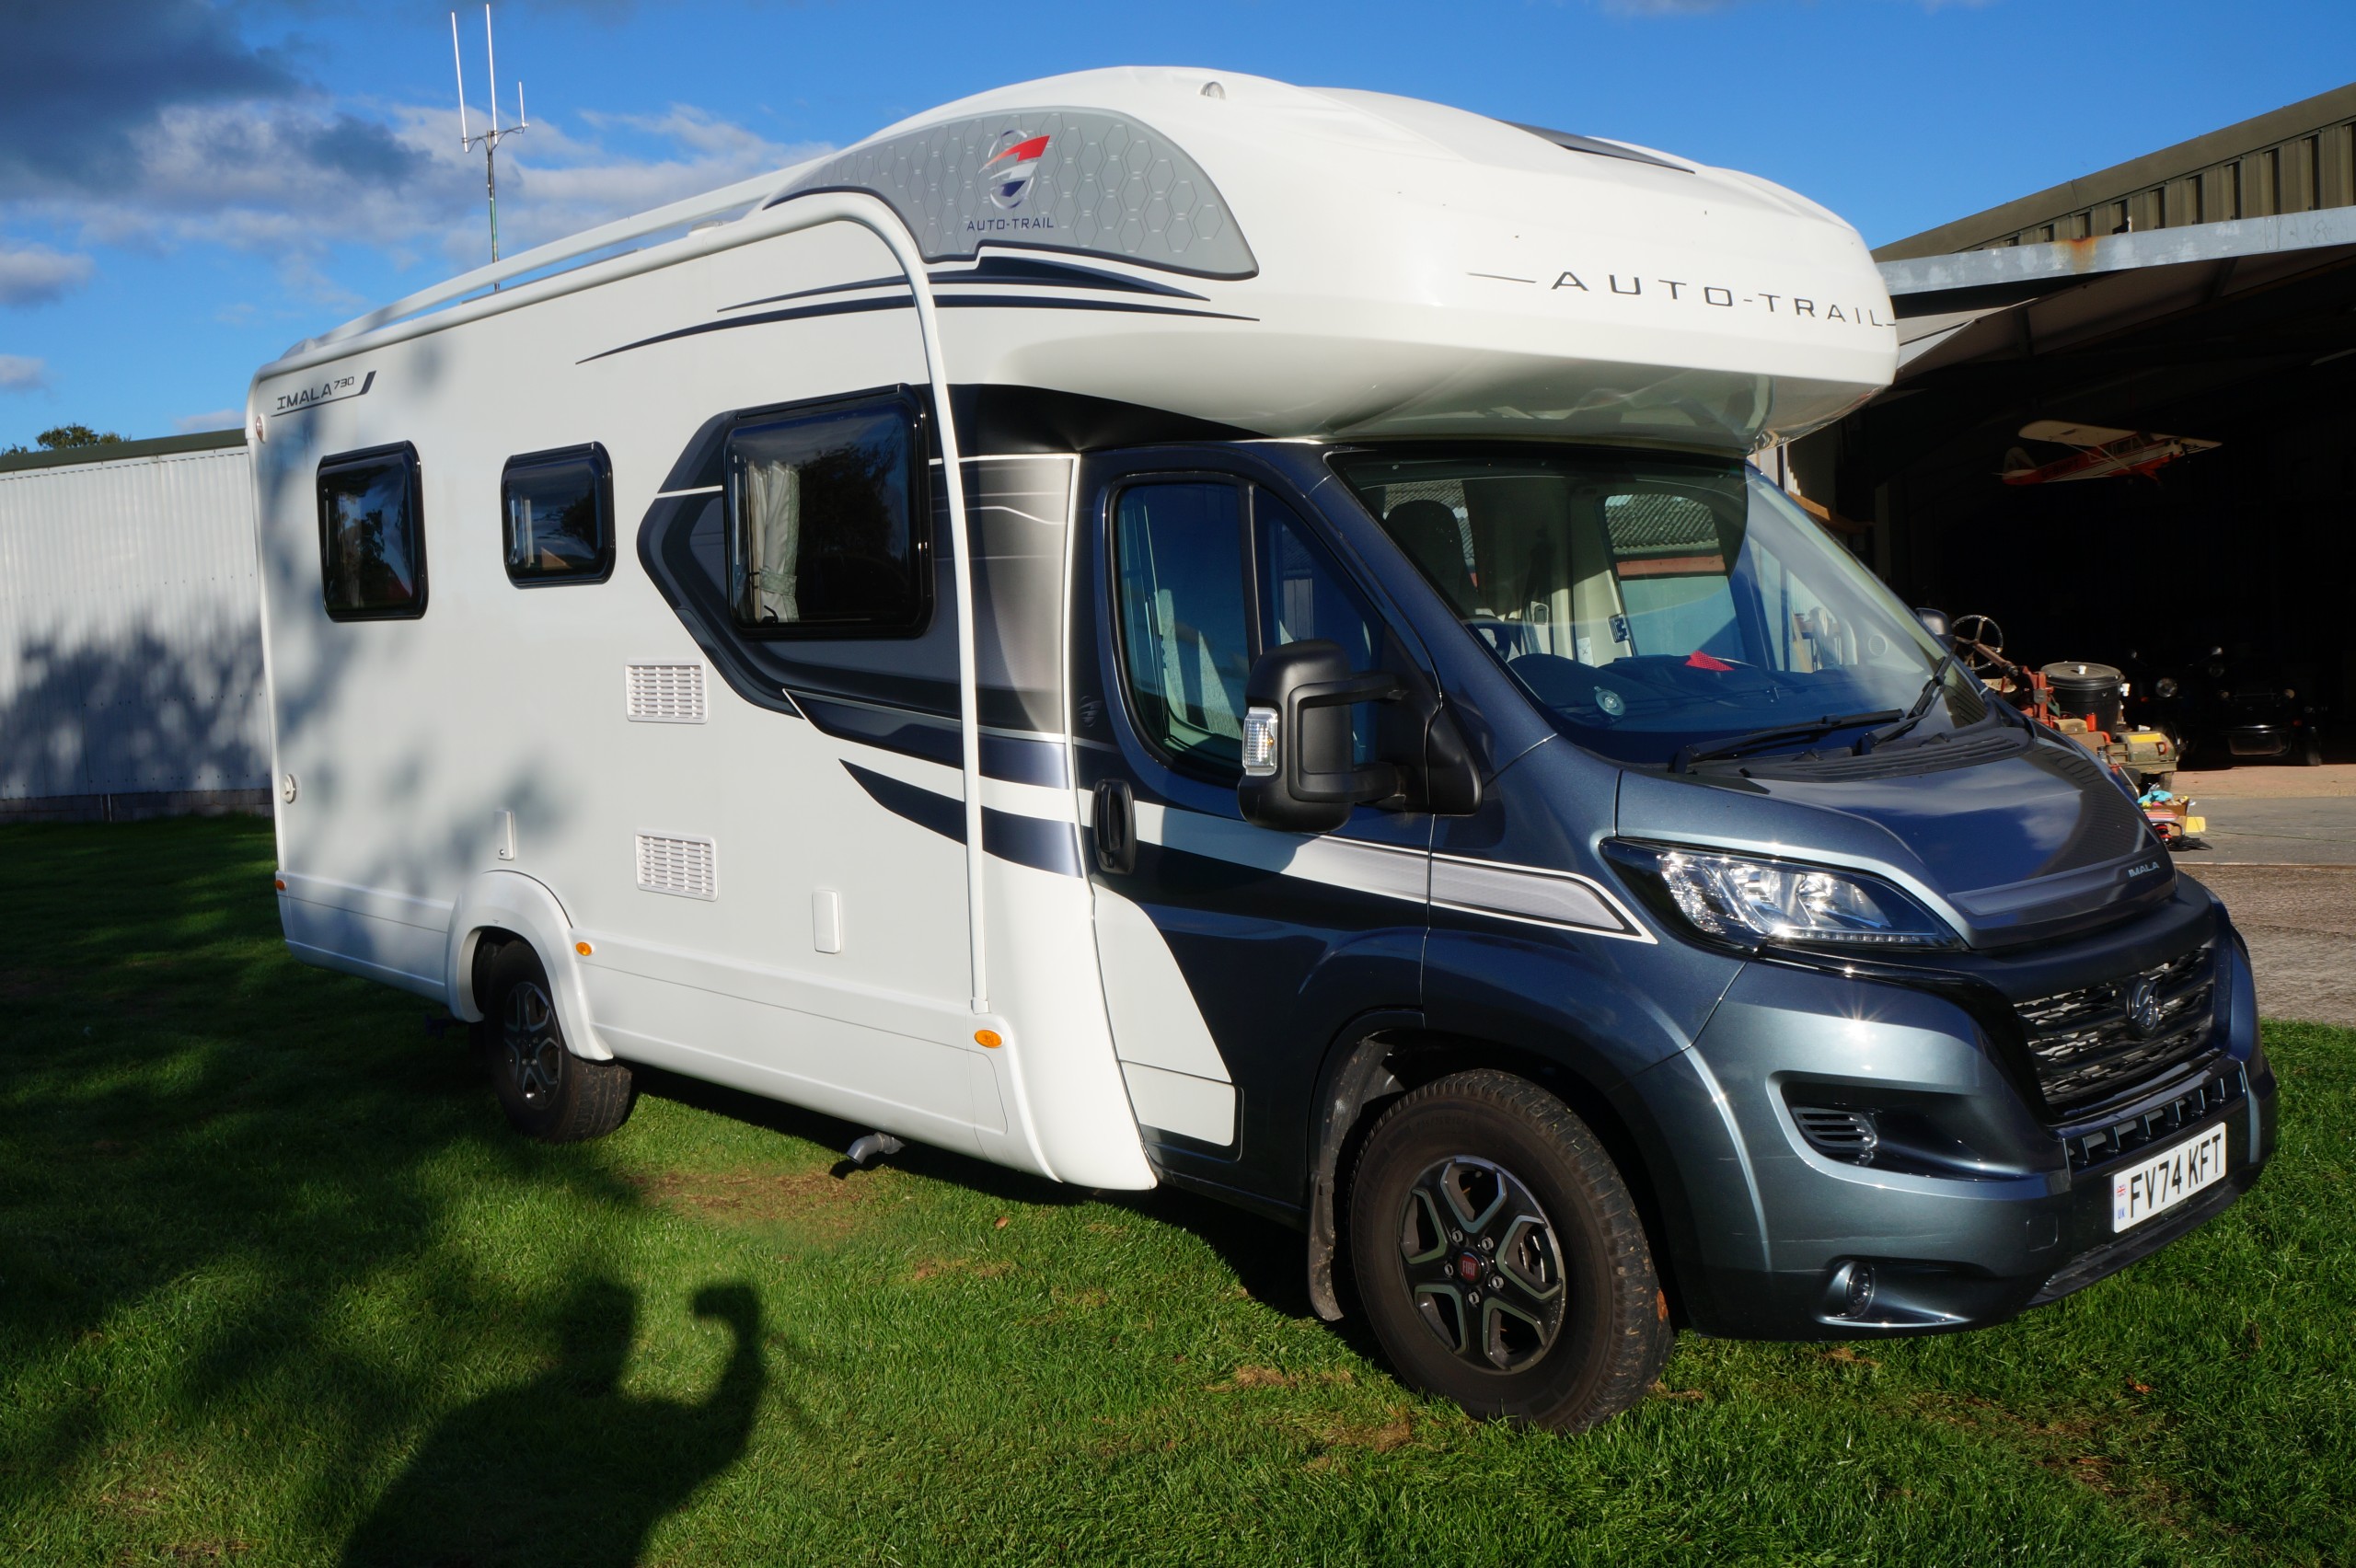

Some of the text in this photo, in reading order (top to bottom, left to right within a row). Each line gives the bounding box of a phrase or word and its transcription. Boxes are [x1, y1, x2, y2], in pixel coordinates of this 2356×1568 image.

[966, 217, 1054, 231] AUTO-TRAIL
[1551, 271, 1884, 327] AUTO-TRAIL
[277, 375, 355, 410] IMALA 730
[2128, 861, 2160, 877] IMALA
[2130, 1133, 2222, 1218] FV74 KFT
[1462, 1260, 1476, 1276] FIAT
